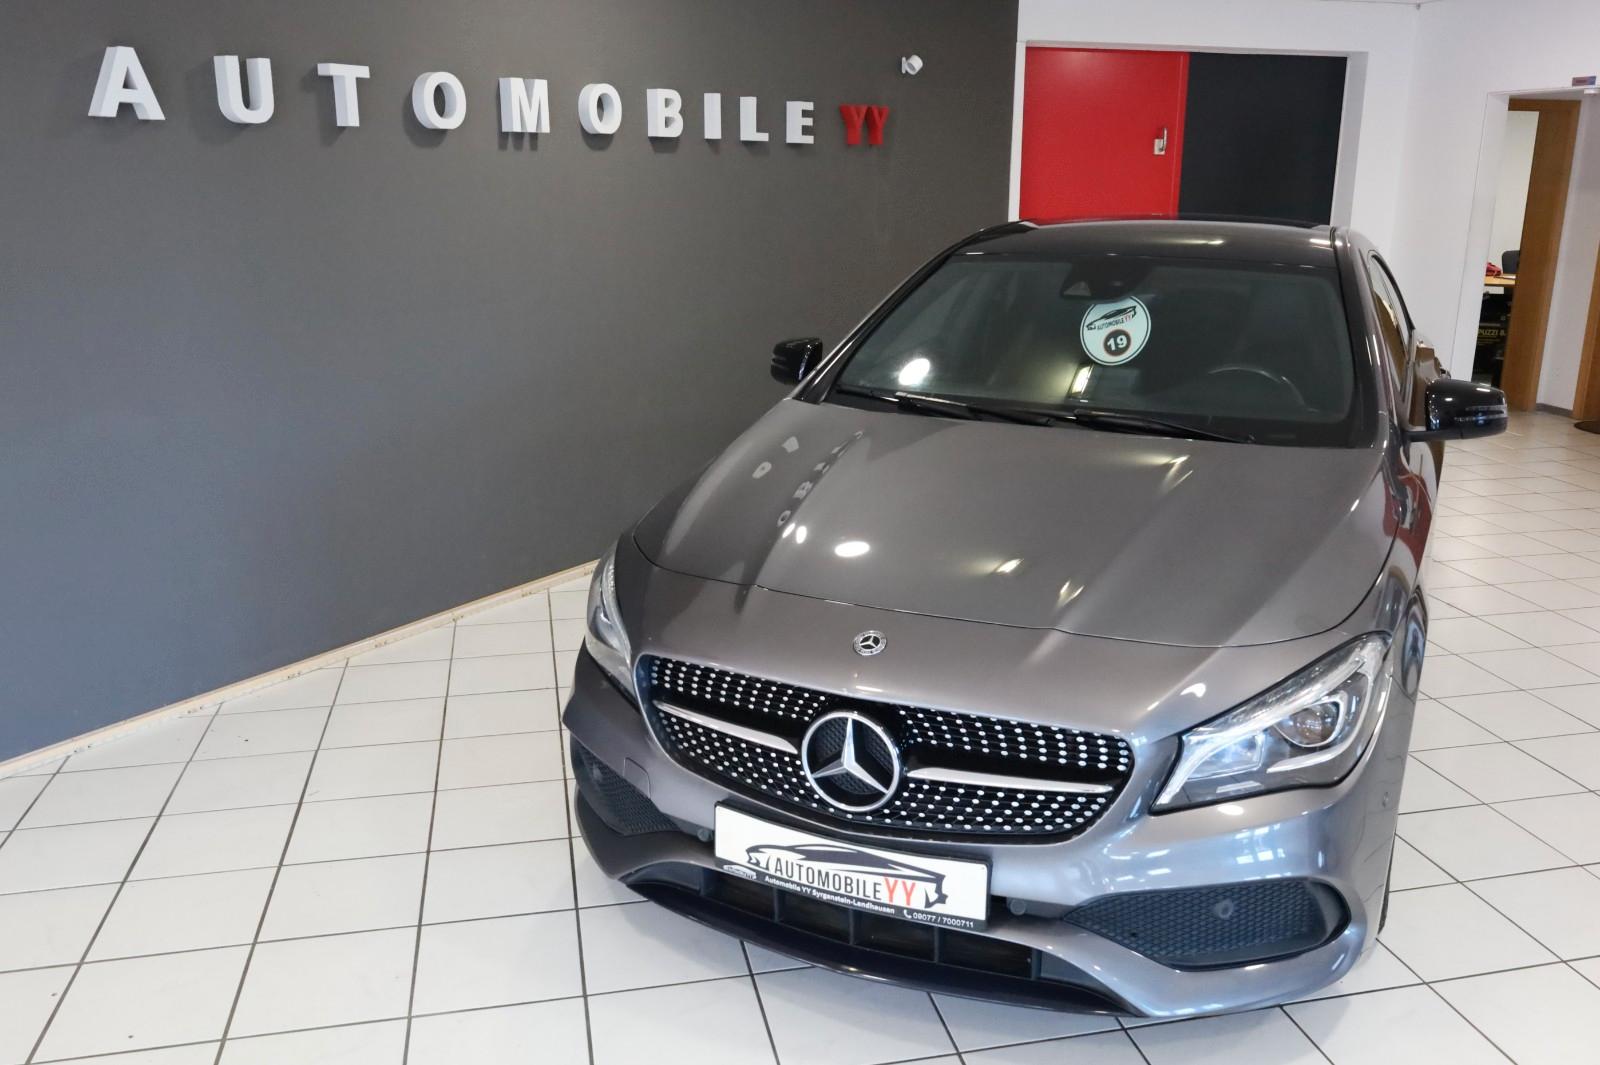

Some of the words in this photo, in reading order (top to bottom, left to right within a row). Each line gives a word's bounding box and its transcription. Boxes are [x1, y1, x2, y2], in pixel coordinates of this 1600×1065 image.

[87, 45, 815, 145] AUTOMOBILE
[839, 103, 890, 147] YY
[1107, 334, 1128, 351] 19
